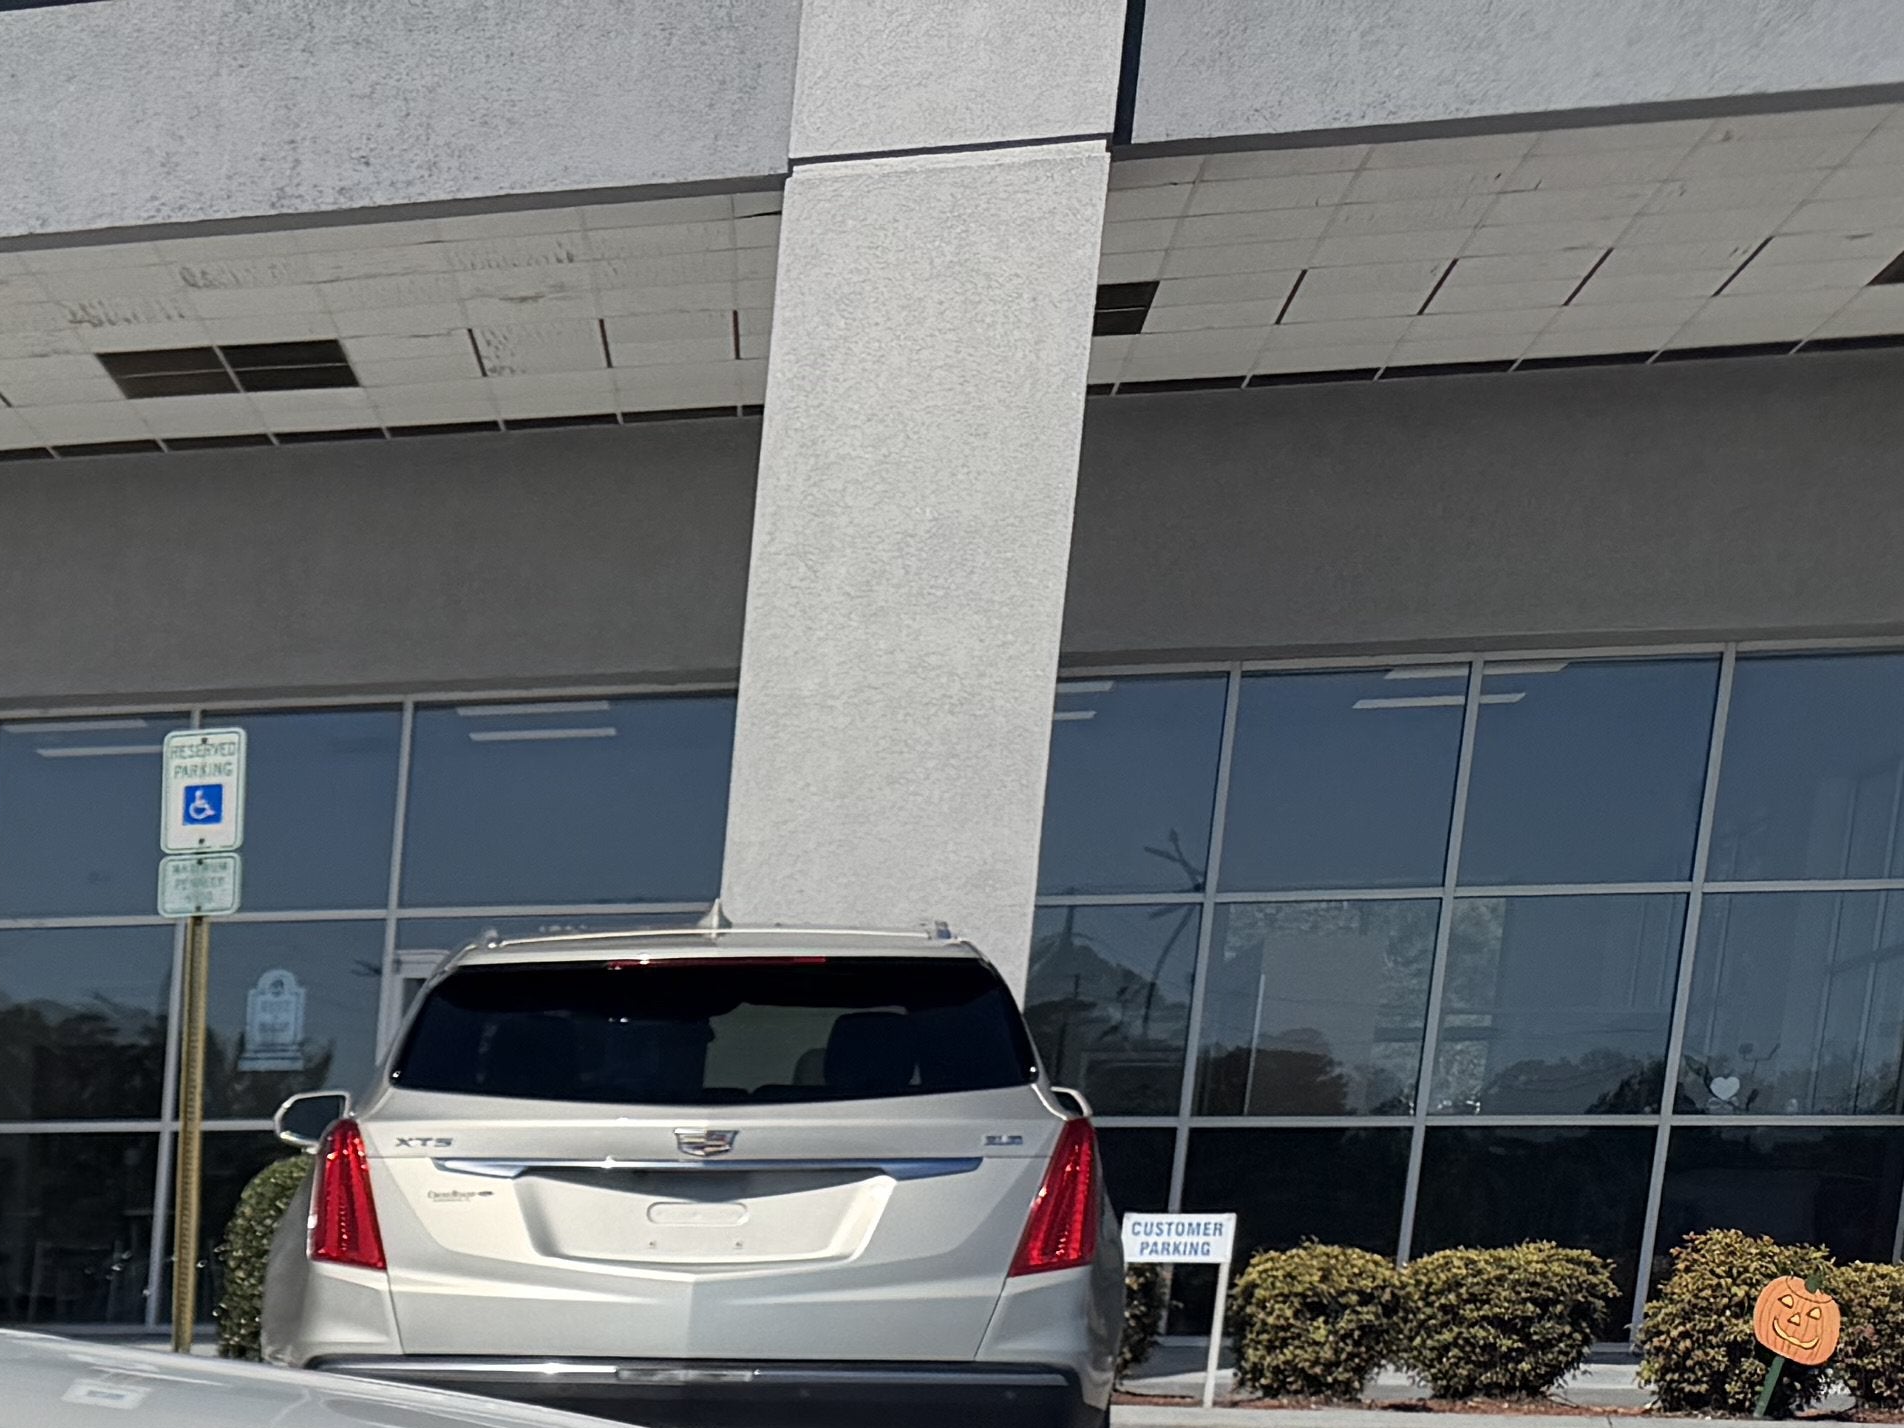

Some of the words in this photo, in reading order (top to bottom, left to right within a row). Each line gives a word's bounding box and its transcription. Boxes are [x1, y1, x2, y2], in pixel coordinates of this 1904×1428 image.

[168, 742, 236, 760] RESERVED
[174, 762, 233, 779] PARKING
[1131, 1221, 1224, 1237] CUSTOMER
[1139, 1241, 1211, 1256] PARKING
